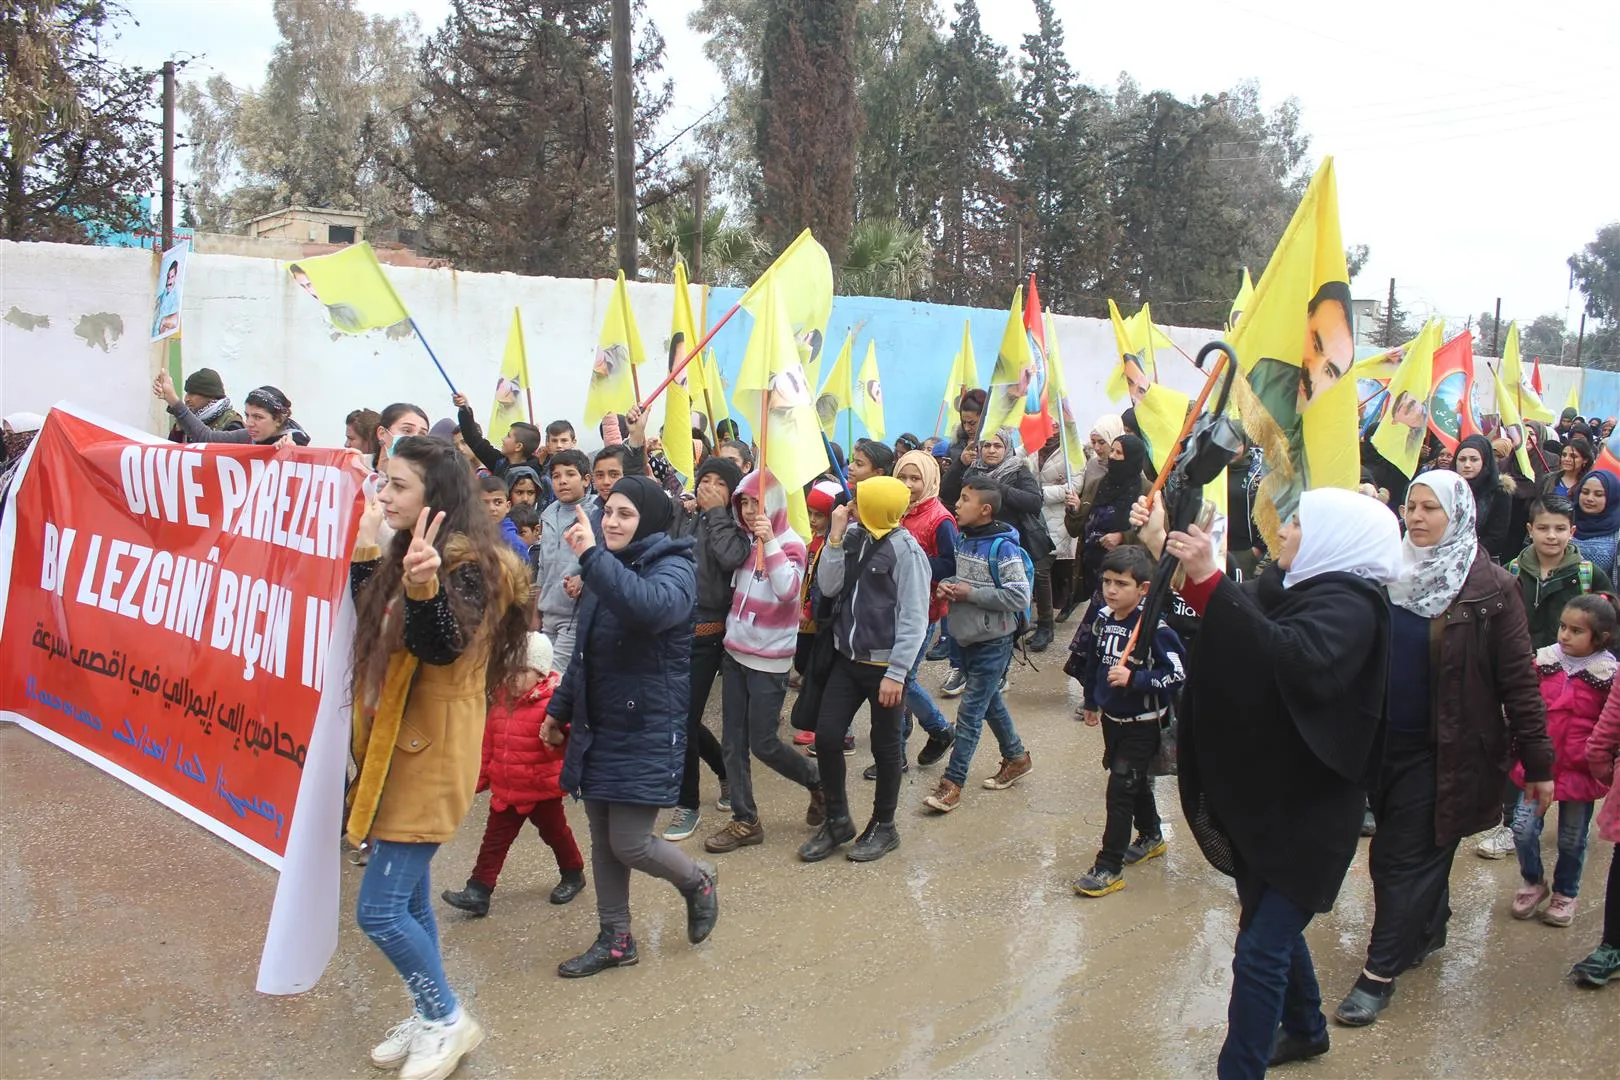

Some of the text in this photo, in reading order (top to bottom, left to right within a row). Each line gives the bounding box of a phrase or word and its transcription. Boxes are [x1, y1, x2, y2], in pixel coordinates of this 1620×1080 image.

[40, 522, 76, 597] BI
[76, 534, 219, 642] LEZGINÎ
[210, 568, 293, 681] BIÇIN
[128, 665, 161, 696] في
[217, 702, 245, 750] إلى
